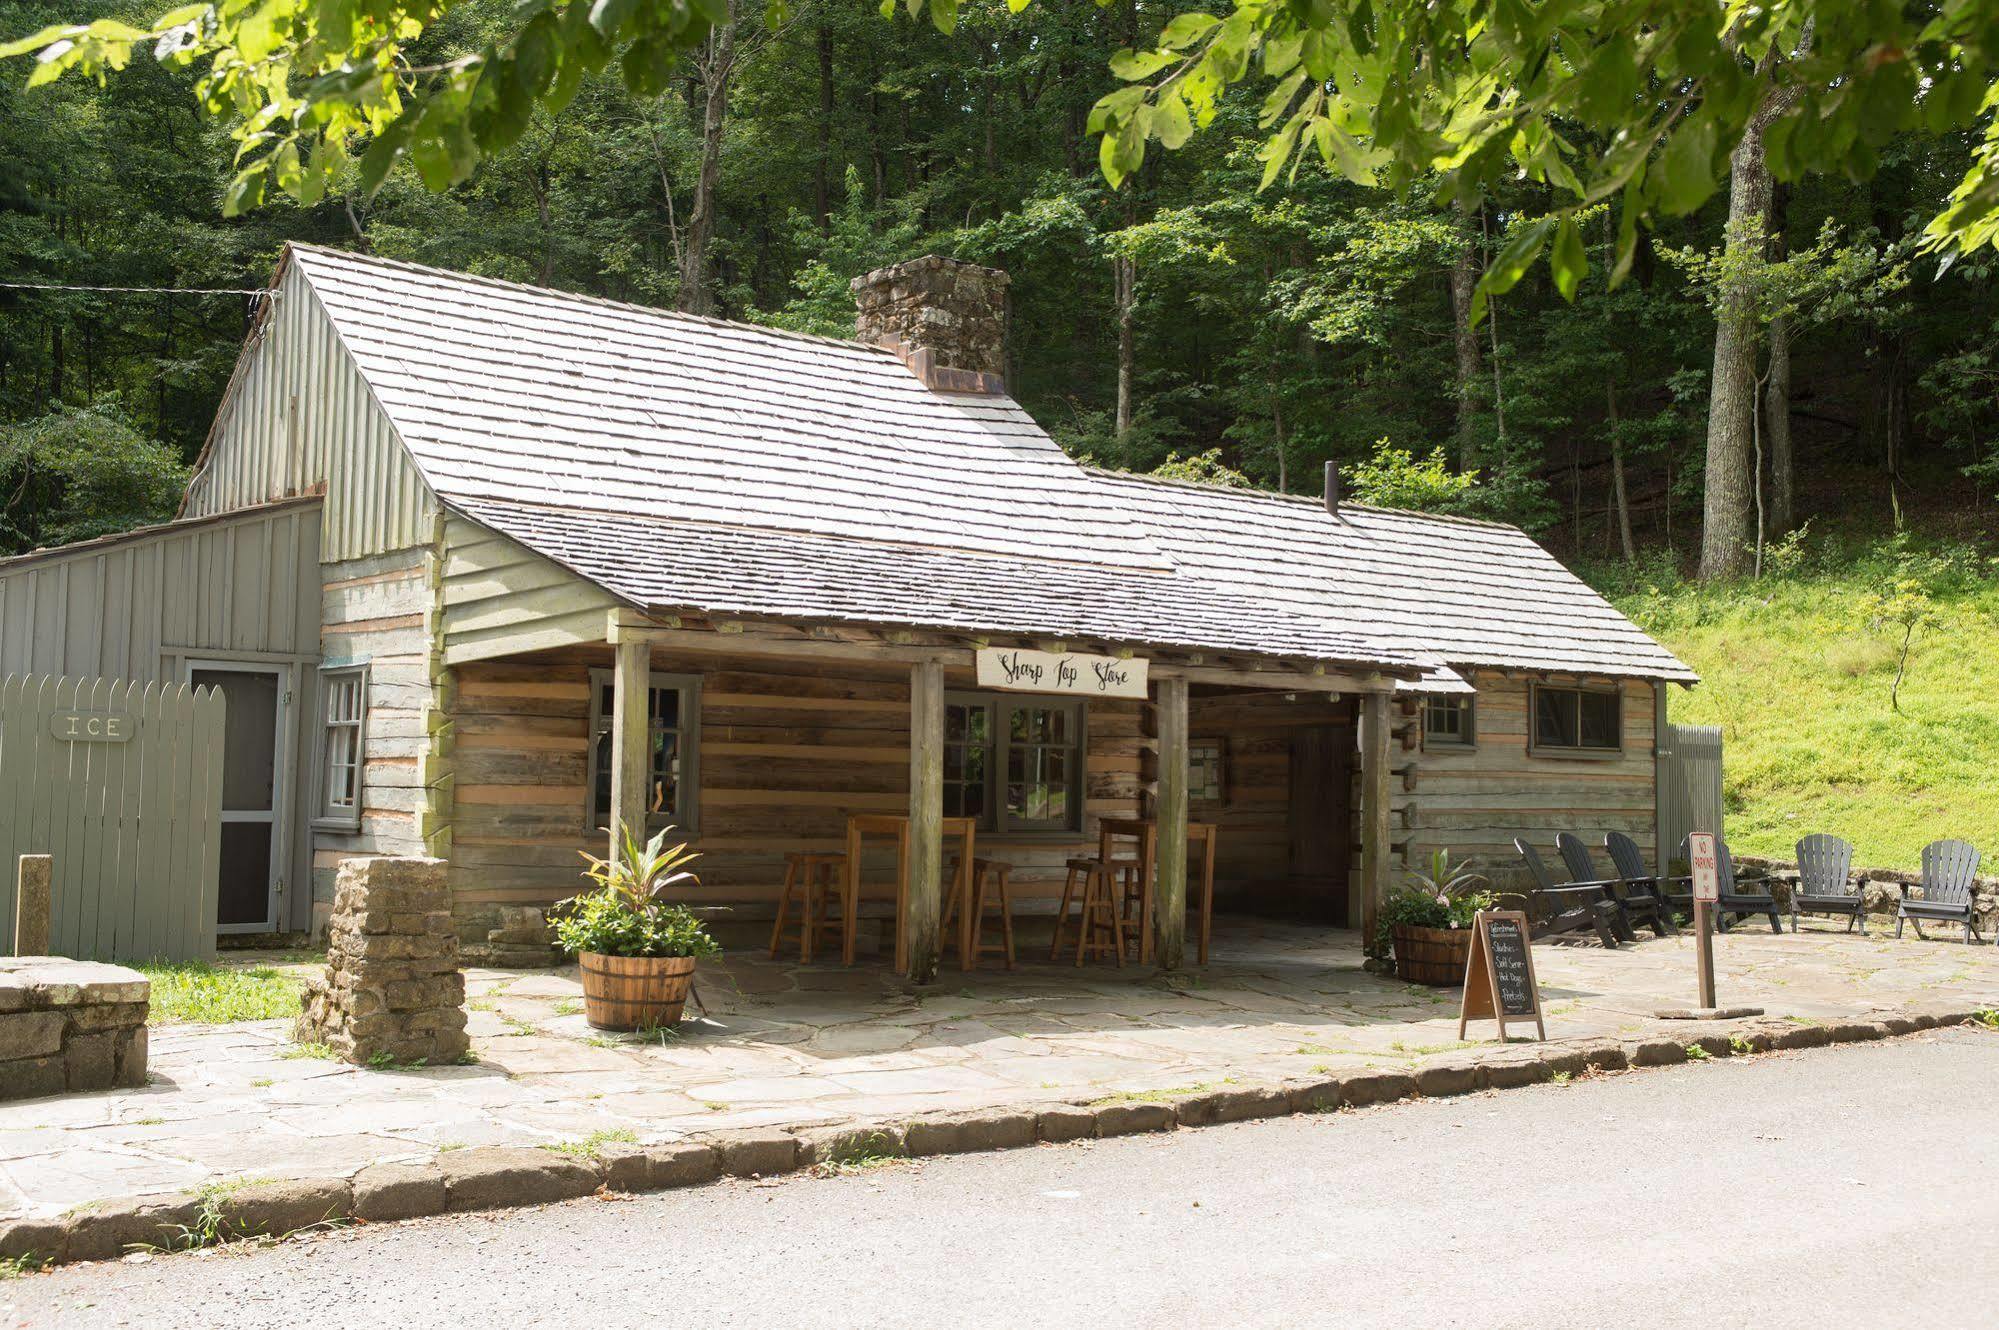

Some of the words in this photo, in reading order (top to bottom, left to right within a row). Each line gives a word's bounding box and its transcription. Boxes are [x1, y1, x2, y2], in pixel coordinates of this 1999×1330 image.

[997, 652, 1043, 685] Sharp
[1053, 655, 1078, 688] Top
[1091, 658, 1129, 691] Store
[65, 716, 121, 736] ICE
[1698, 841, 1707, 854] NO
[1694, 856, 1714, 870] PARKING
